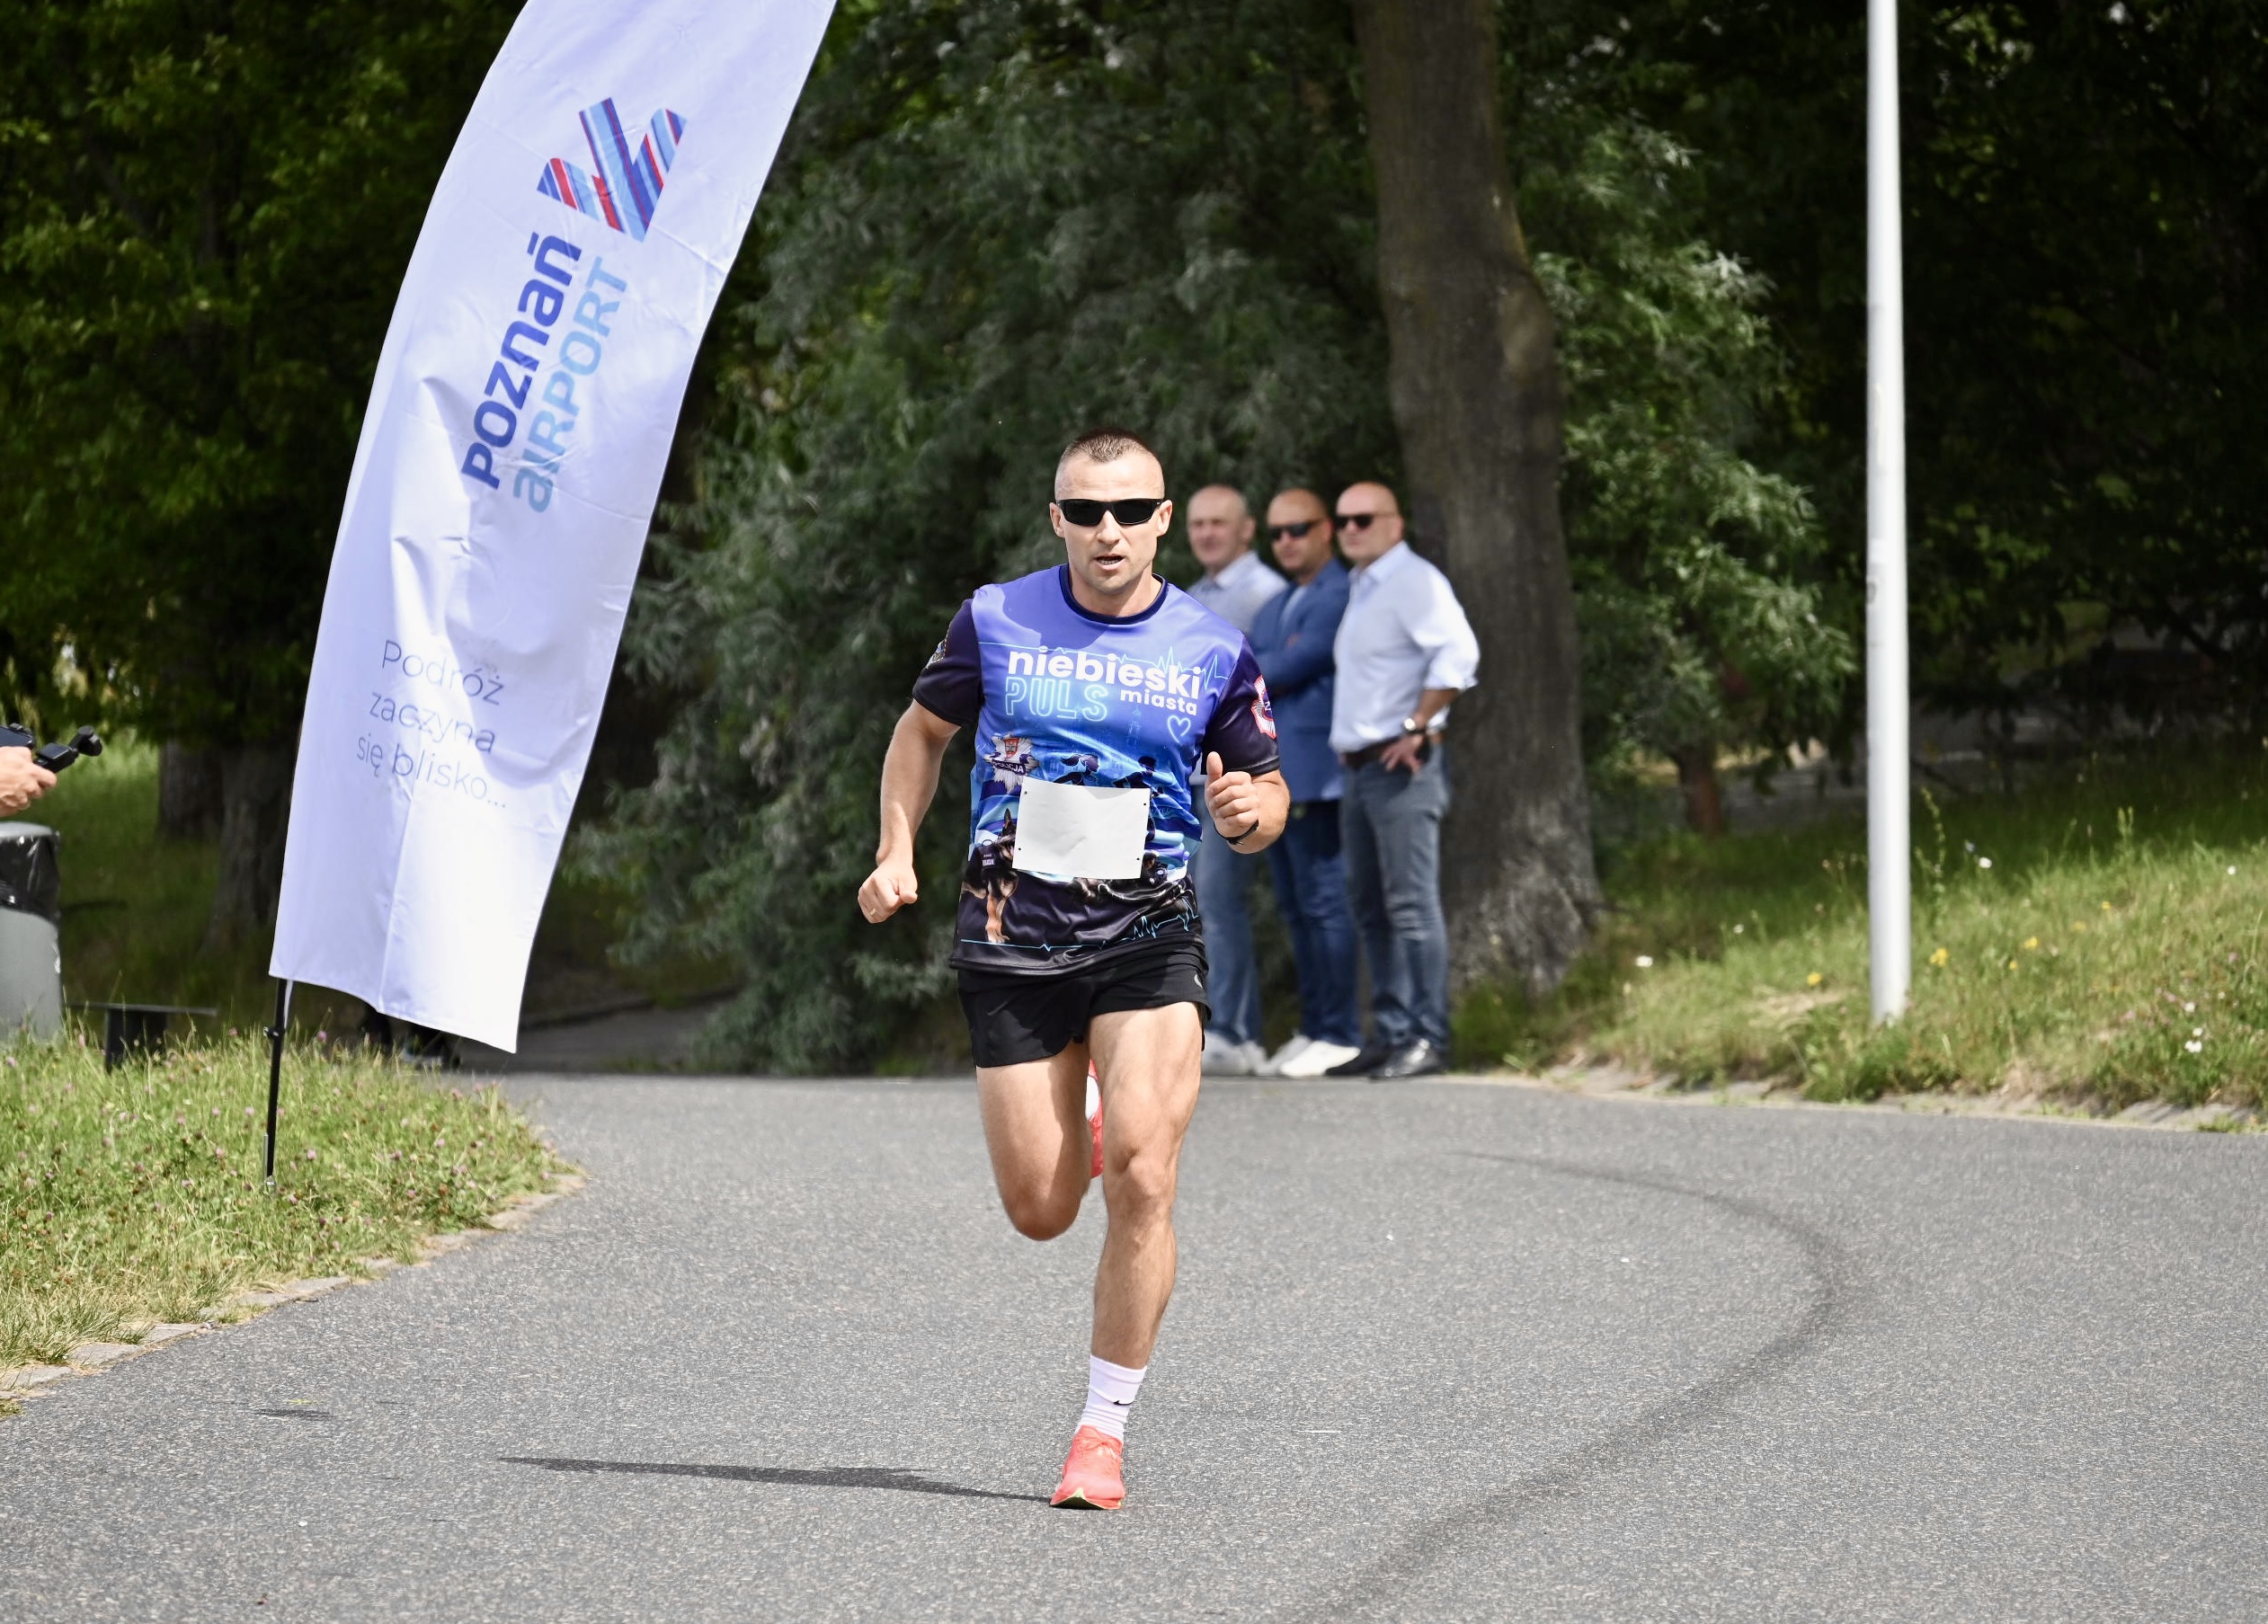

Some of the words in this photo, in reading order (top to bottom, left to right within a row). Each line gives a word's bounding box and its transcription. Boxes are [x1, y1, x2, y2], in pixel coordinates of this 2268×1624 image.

[382, 640, 504, 706] Podróż
[1005, 676, 1108, 722] PULS
[1120, 689, 1197, 715] miasta
[1008, 645, 1201, 700] niebieski
[369, 691, 495, 753] zaczyna
[356, 732, 384, 777] się
